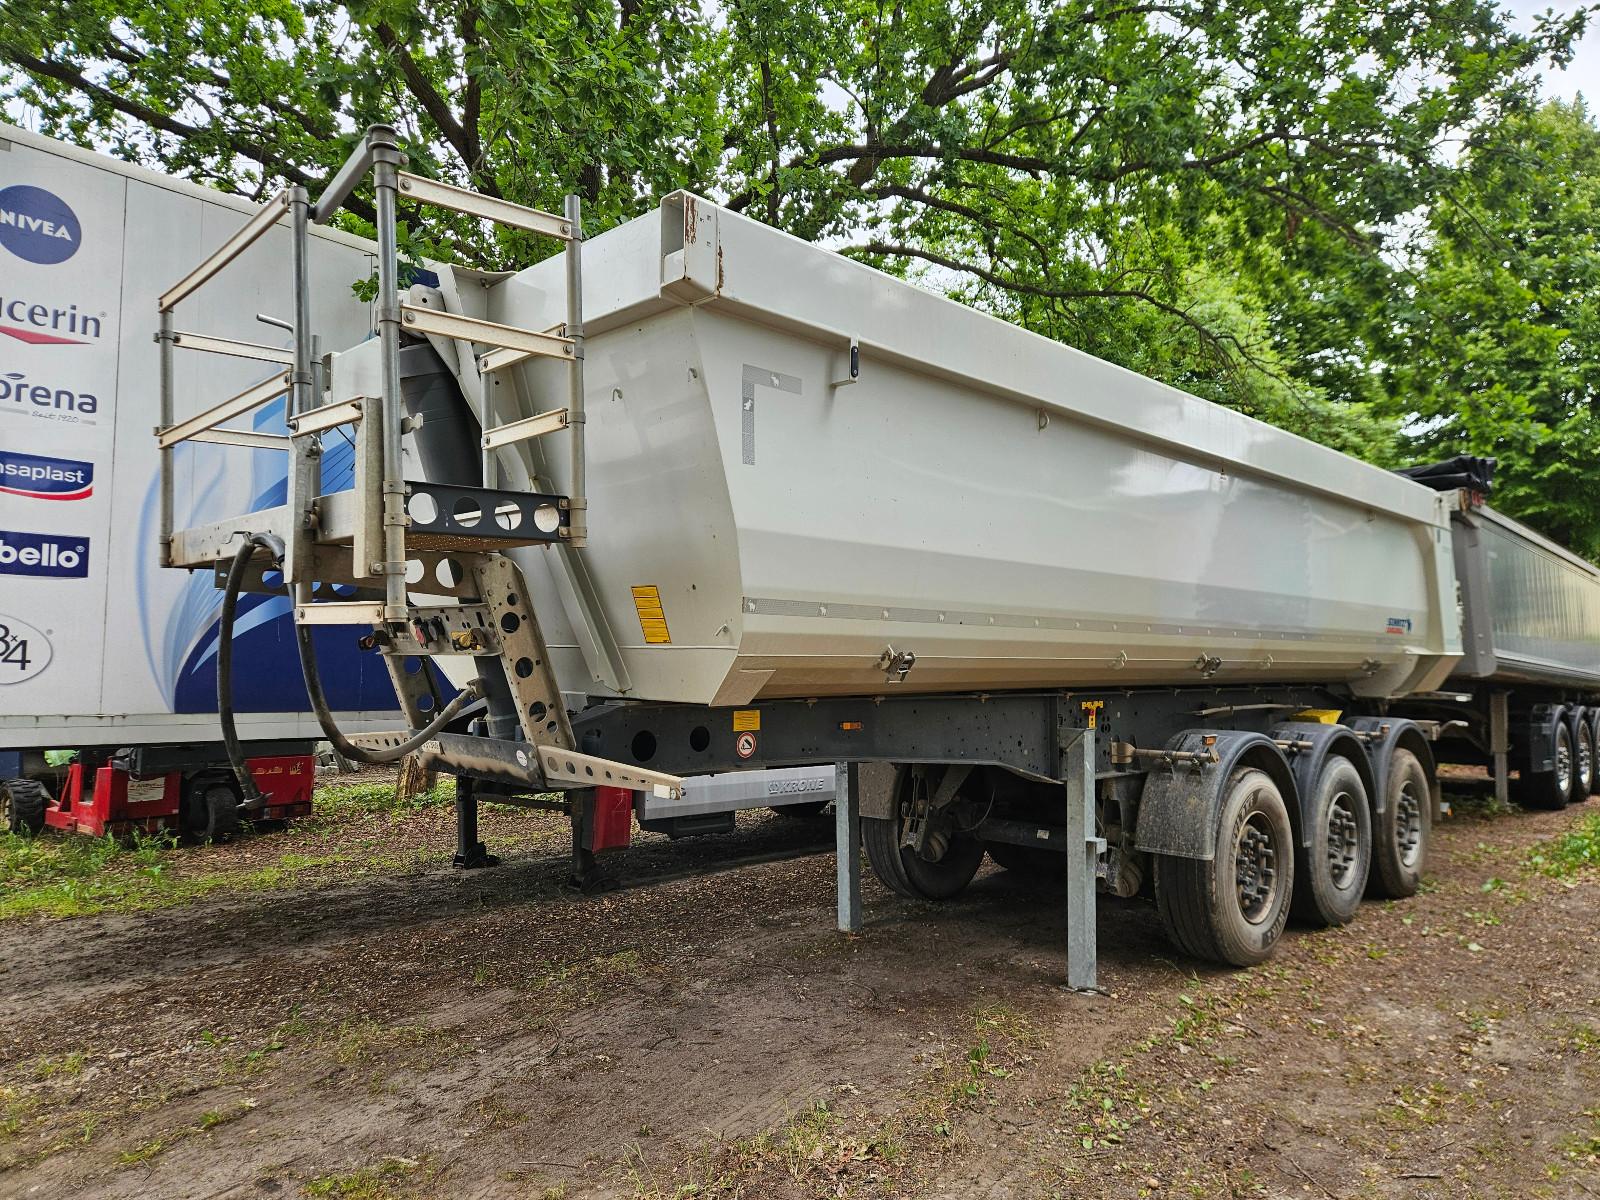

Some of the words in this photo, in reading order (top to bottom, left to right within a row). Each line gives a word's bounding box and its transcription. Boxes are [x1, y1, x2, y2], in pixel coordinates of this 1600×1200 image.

[0, 208, 72, 241] NIVEA
[0, 296, 100, 338] cerin
[779, 778, 824, 793] KRONE
